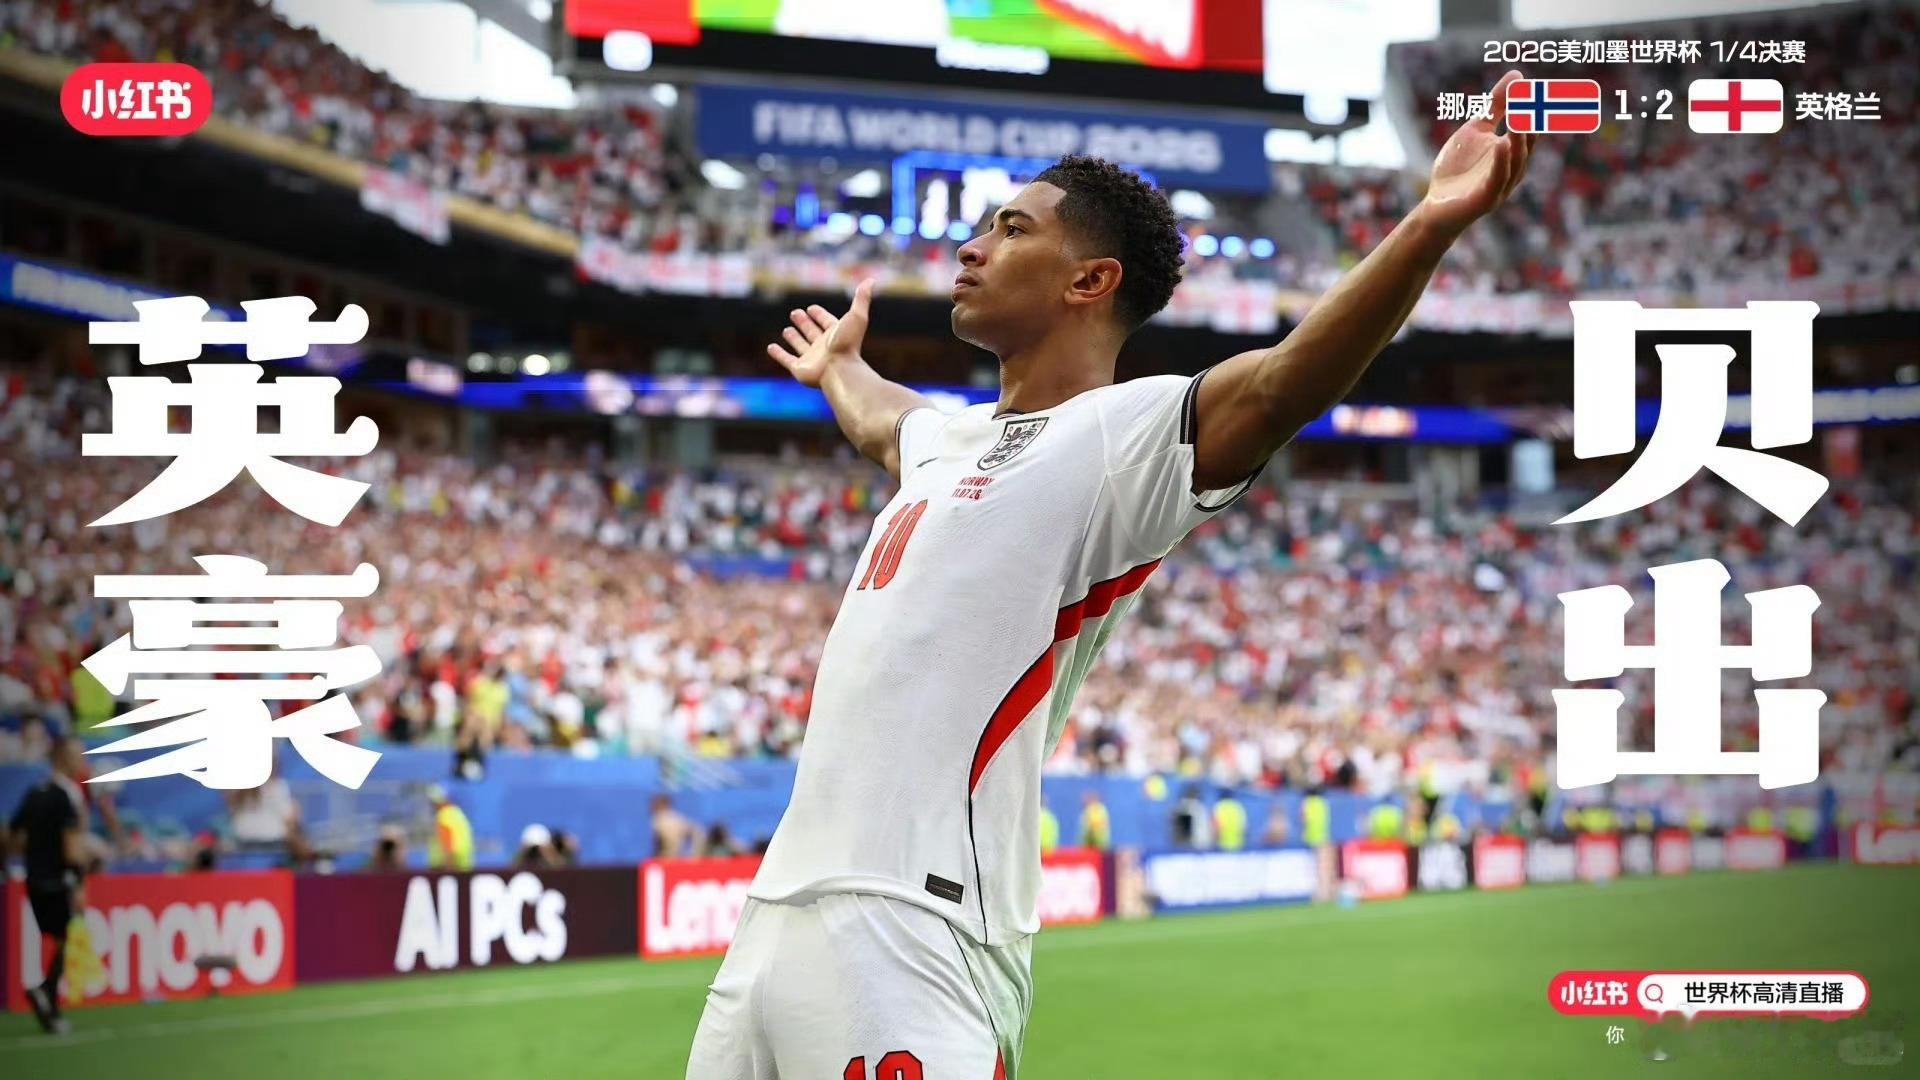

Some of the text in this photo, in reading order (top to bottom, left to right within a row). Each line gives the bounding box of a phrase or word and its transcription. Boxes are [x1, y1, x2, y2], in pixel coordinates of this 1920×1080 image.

[753, 102, 1222, 173] FIFA WORLD CUP 2026
[959, 475, 995, 487] NORWAY
[856, 499, 928, 590] 10
[395, 872, 567, 972] AI PCs
